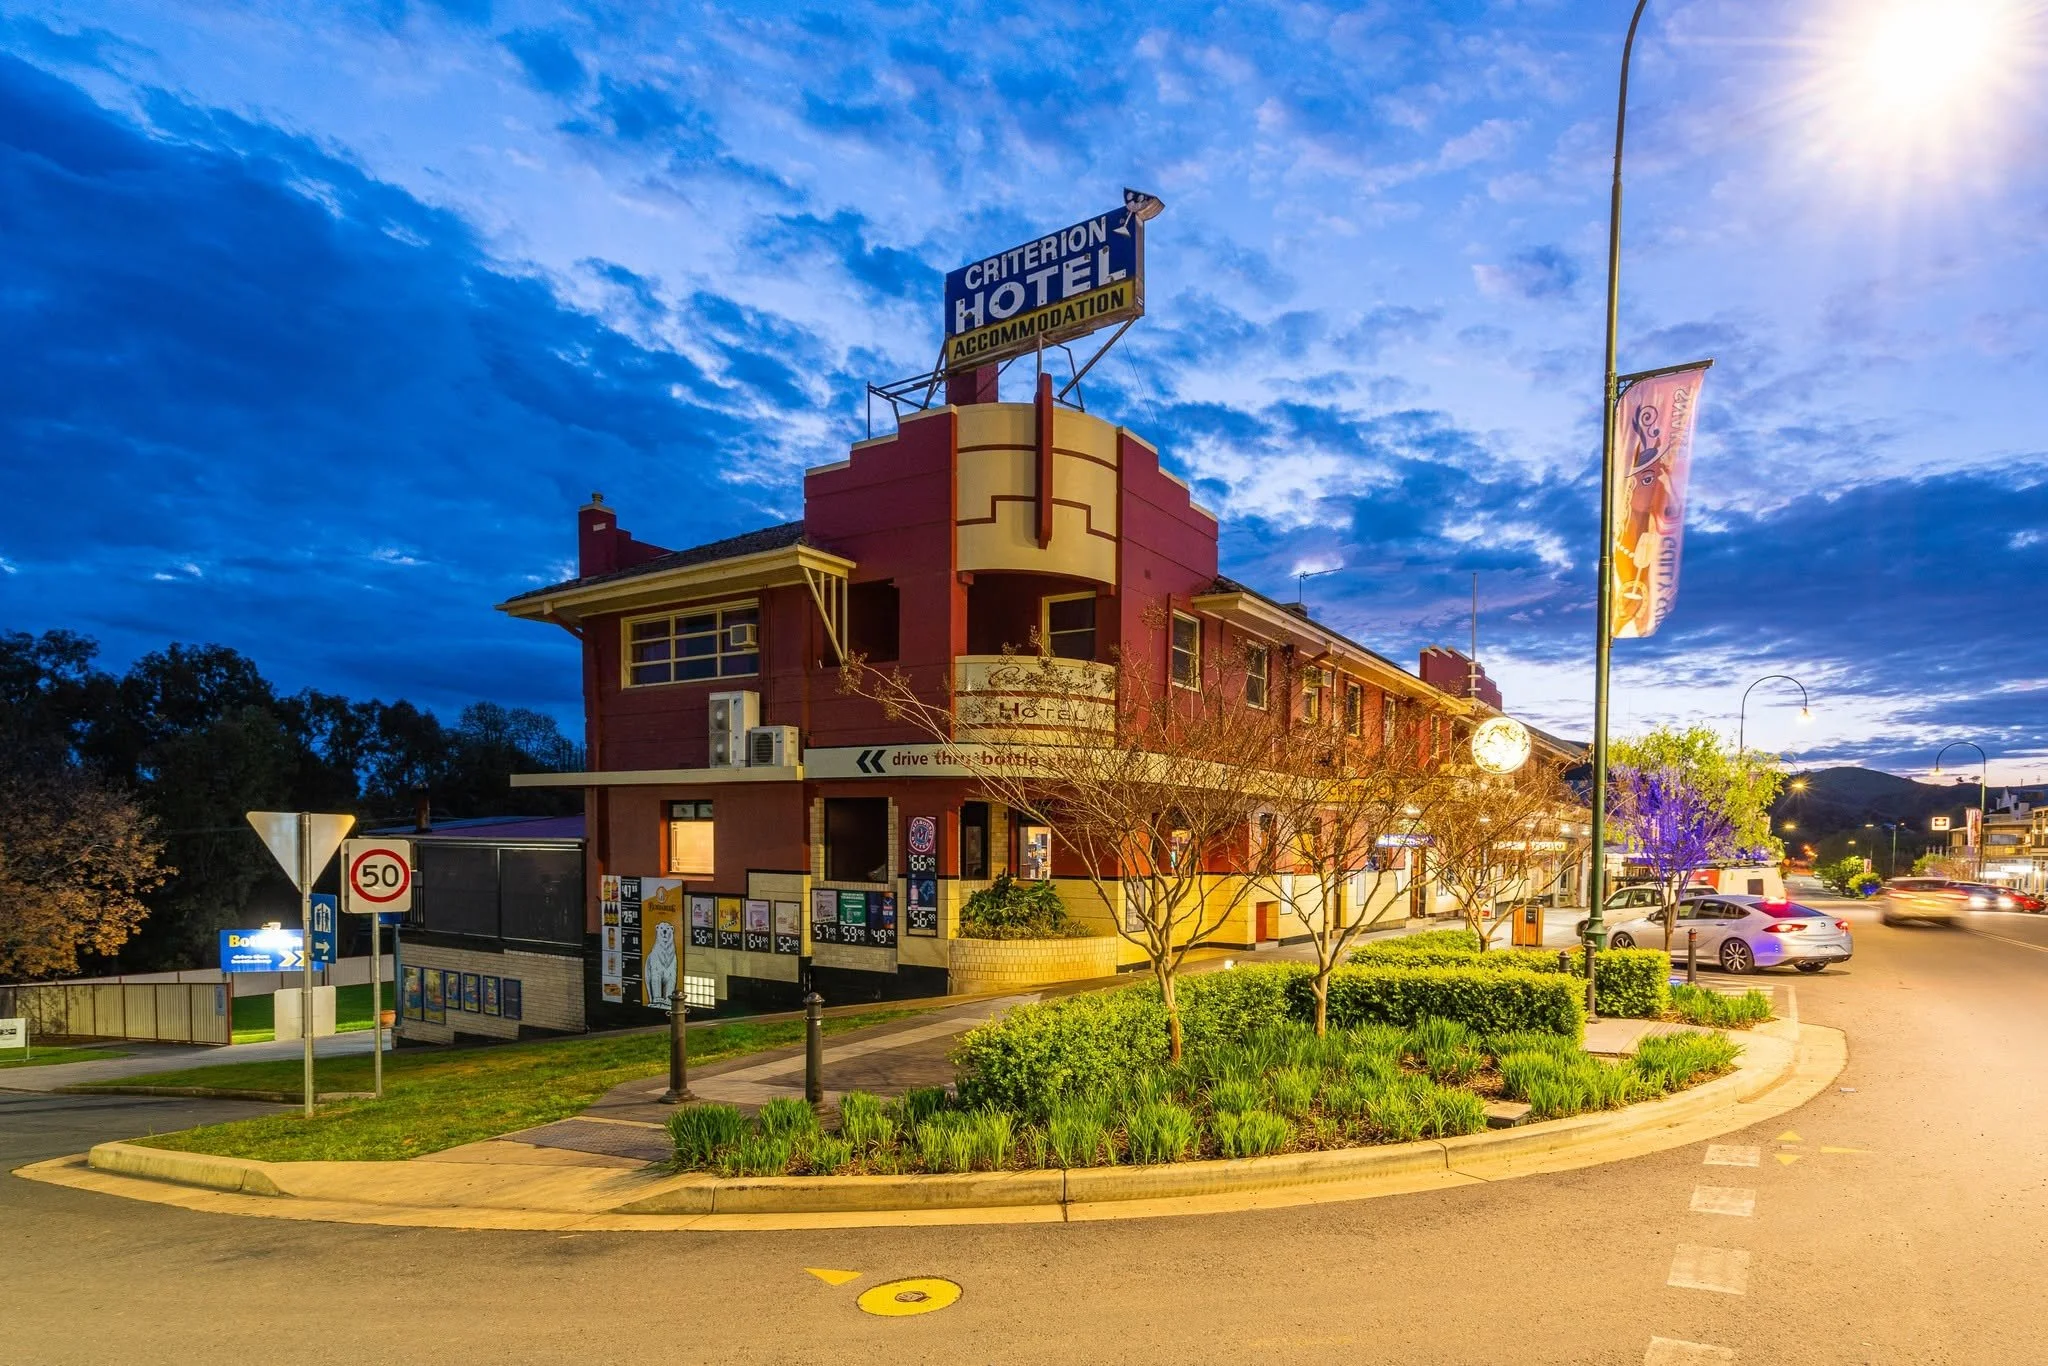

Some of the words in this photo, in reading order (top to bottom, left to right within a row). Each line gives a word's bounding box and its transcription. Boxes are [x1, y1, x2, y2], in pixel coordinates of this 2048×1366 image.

[965, 216, 1107, 290] CRITERION
[953, 288, 1125, 360] ACCOMMODATION
[955, 245, 1127, 334] HOTEL
[892, 752, 928, 766] drive
[362, 865, 399, 887] 50
